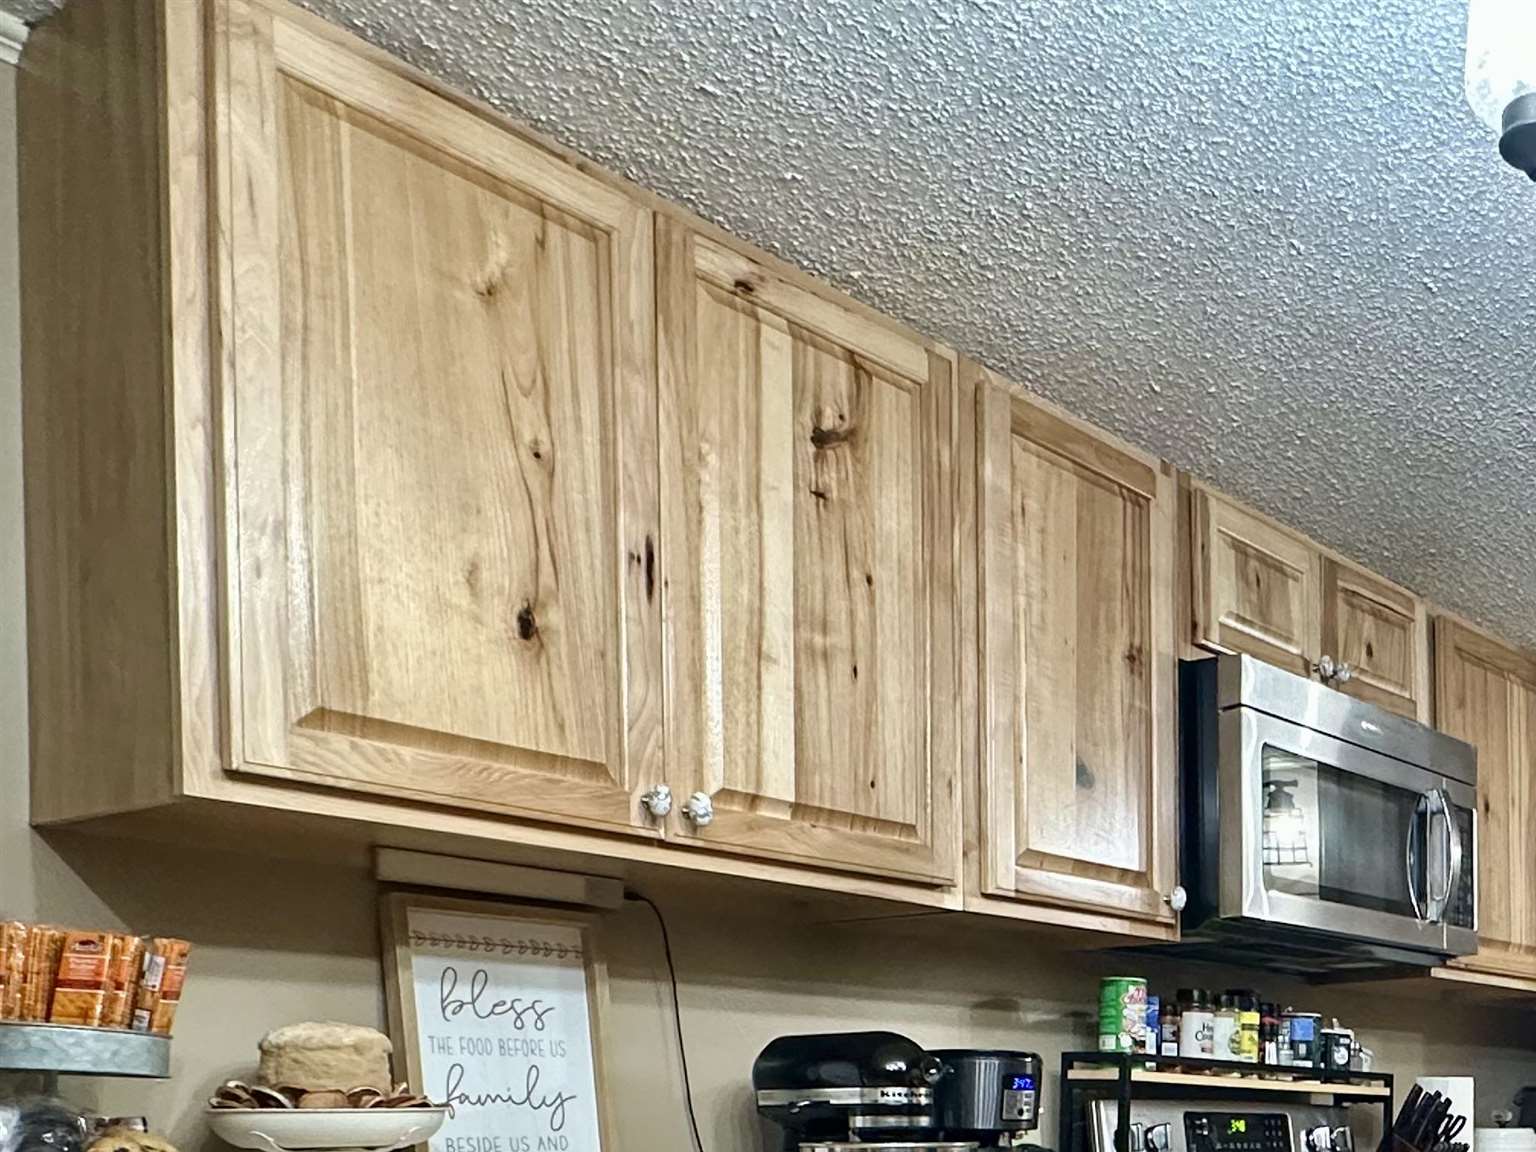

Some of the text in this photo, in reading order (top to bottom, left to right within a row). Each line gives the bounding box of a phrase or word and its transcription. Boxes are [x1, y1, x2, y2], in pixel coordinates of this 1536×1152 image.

[440, 966, 555, 1031] bless
[427, 1035, 567, 1057] THE FOOD BEFORE US
[446, 1063, 577, 1132] family
[509, 1136, 531, 1152] US
[537, 1135, 568, 1151] AND
